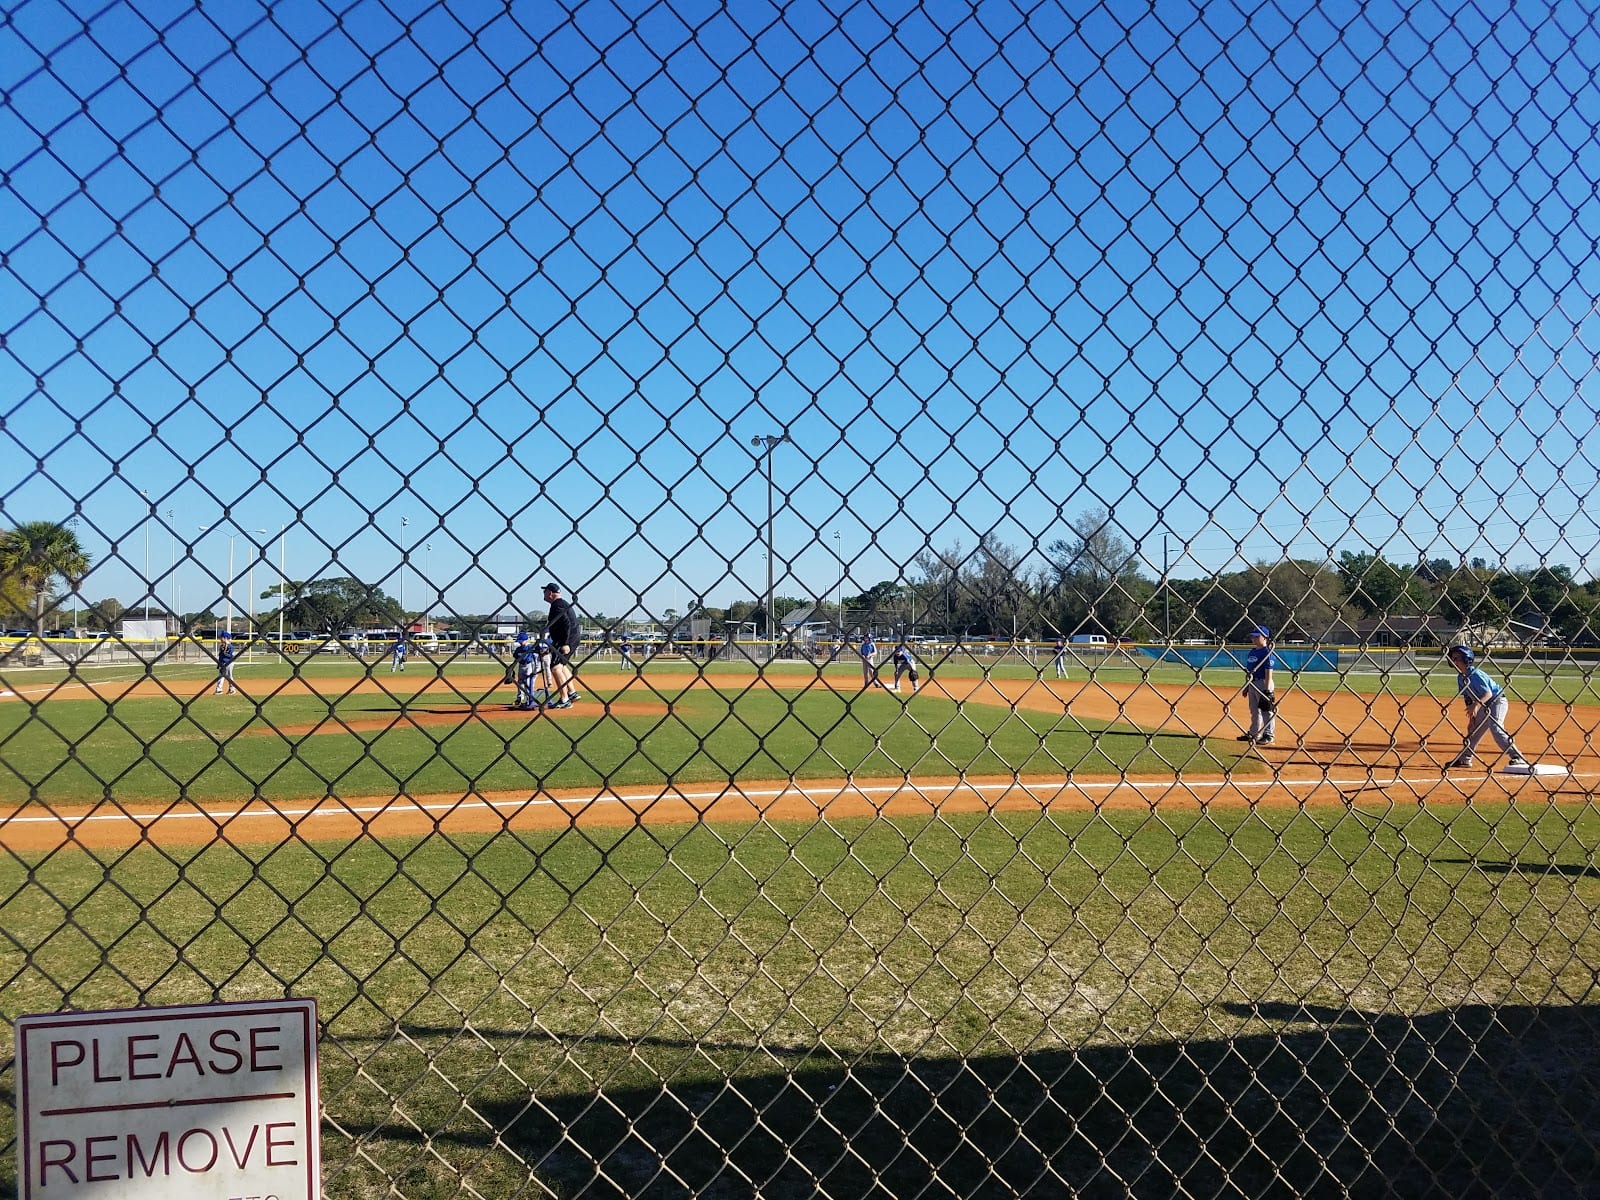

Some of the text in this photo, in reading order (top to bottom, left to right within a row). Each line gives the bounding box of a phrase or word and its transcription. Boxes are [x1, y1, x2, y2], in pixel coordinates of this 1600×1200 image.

[283, 644, 299, 653] 200
[51, 1026, 283, 1086] PLEASE
[39, 1122, 298, 1187] REMOVE
